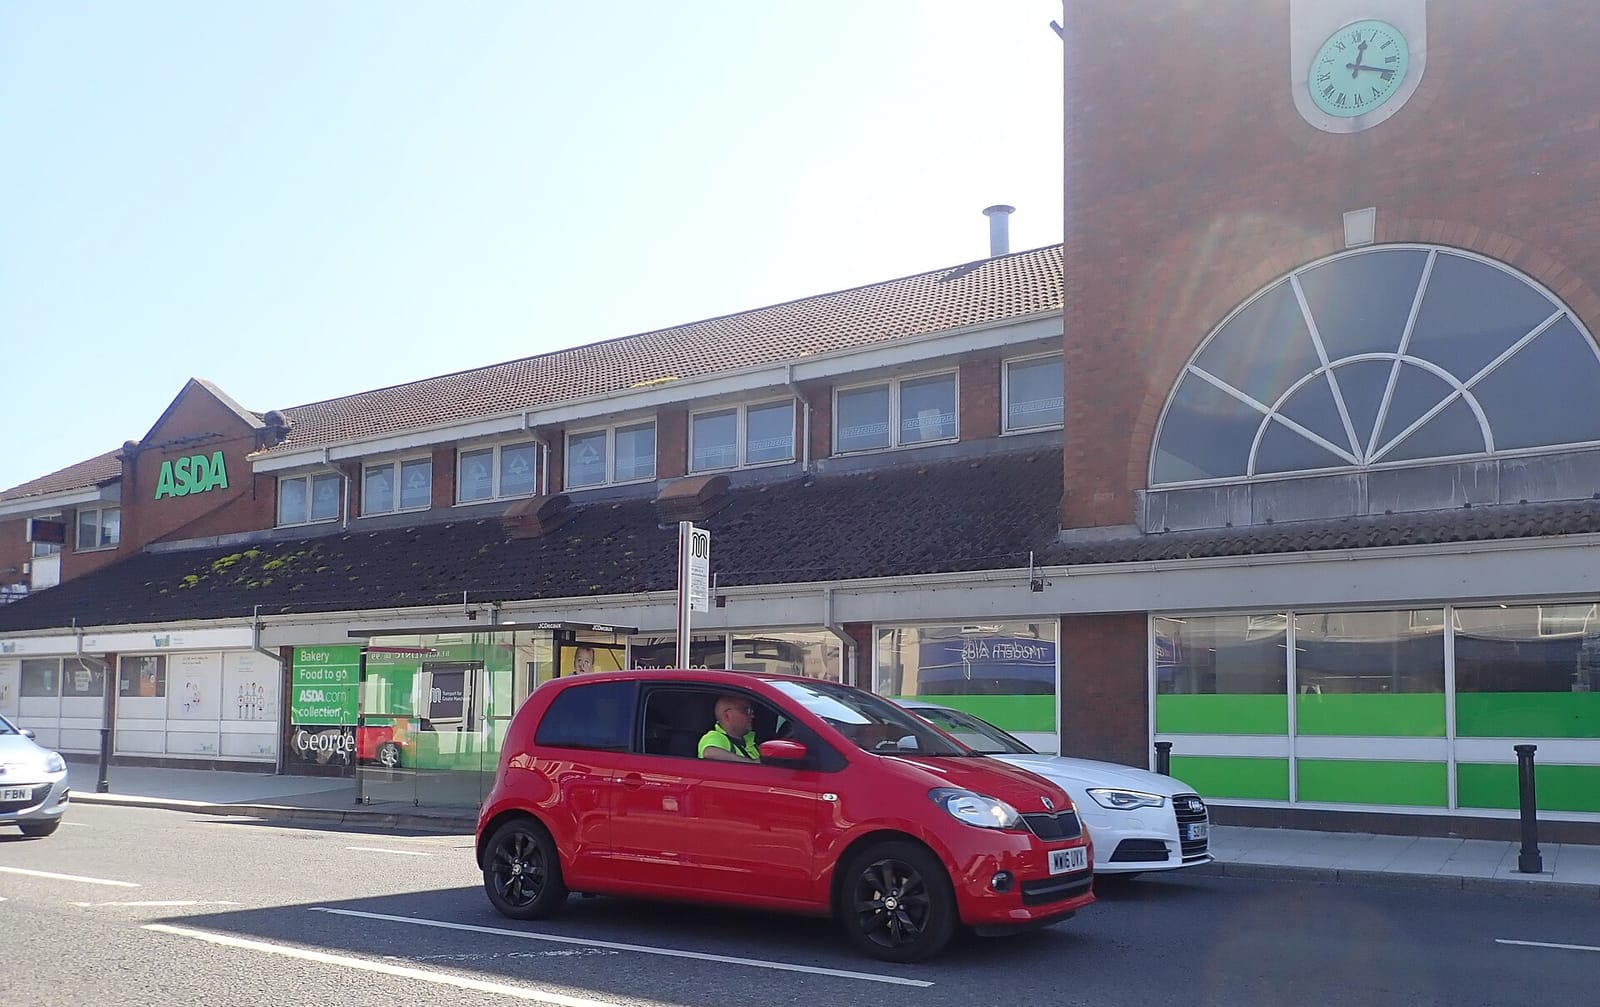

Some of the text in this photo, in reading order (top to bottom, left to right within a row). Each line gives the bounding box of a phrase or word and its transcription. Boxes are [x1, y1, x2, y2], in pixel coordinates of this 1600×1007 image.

[154, 451, 228, 500] ASDA
[300, 650, 330, 663] Bakery
[300, 669, 347, 681] Food to go
[299, 689, 347, 703] ASDA.com
[299, 706, 341, 717] collection
[4, 790, 26, 799] FBN
